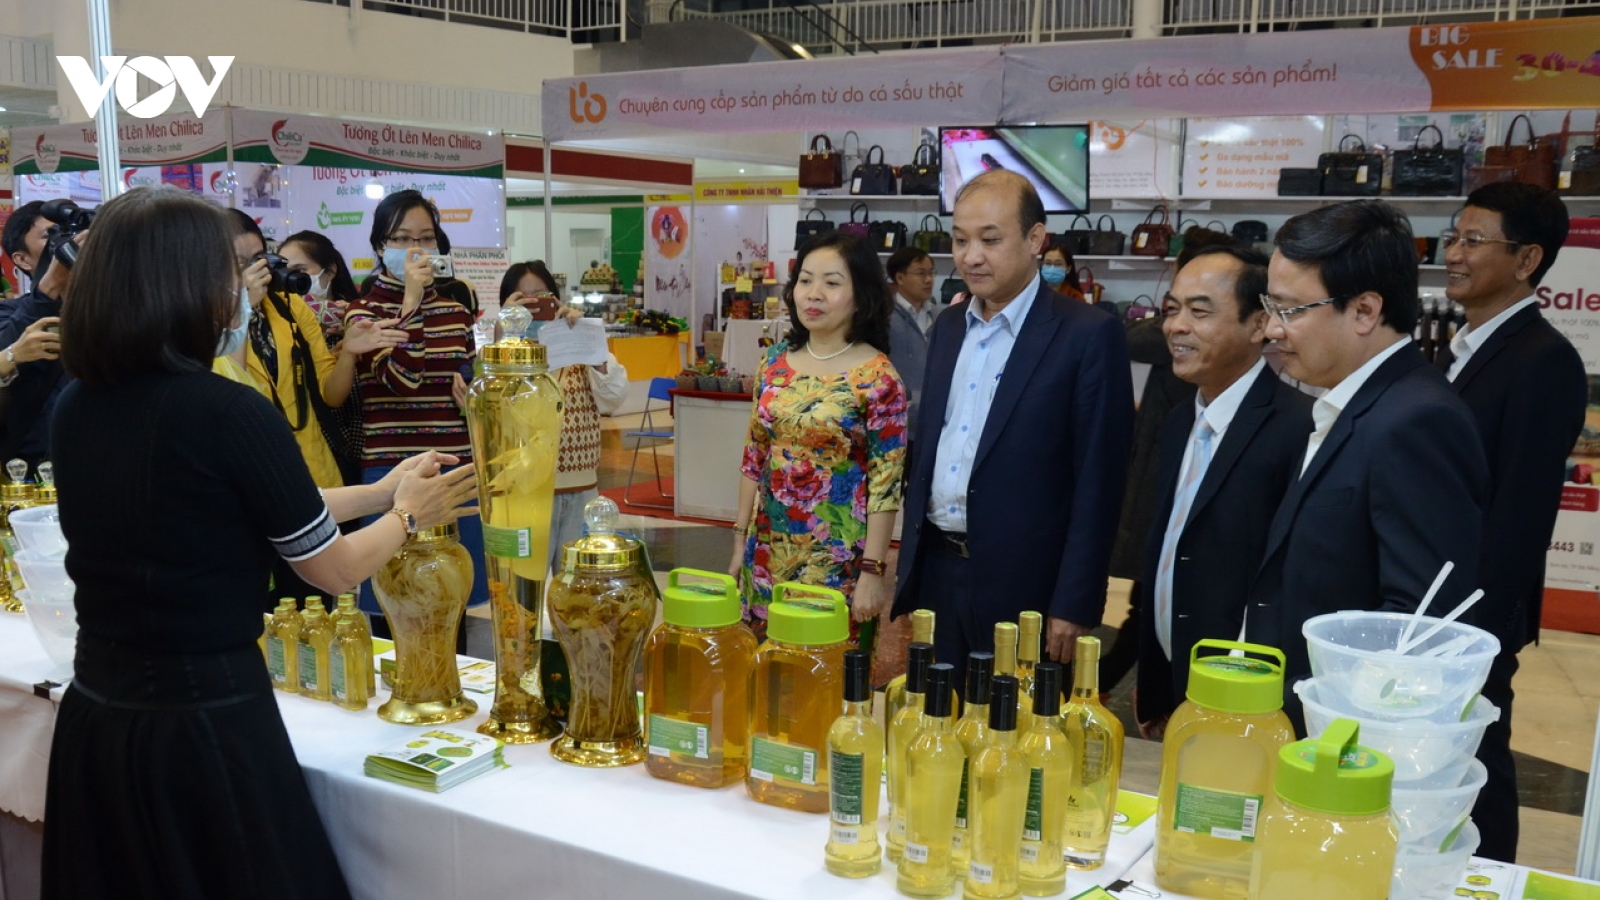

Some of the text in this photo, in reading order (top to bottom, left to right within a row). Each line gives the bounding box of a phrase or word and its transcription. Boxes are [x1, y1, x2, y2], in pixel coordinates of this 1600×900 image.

[1420, 26, 1470, 46] BIG
[1431, 48, 1504, 70] SALE
[1048, 58, 1338, 95] Giảm giá tất cả các sản phẩm!
[619, 78, 964, 117] Chuyên cung cấp sản phẩm từ da cá sấu thật
[125, 124, 143, 140] Lên
[146, 123, 167, 139] Men
[169, 120, 204, 137] Chilica
[342, 124, 482, 150] Tương Ớt Lên Men Chilica
